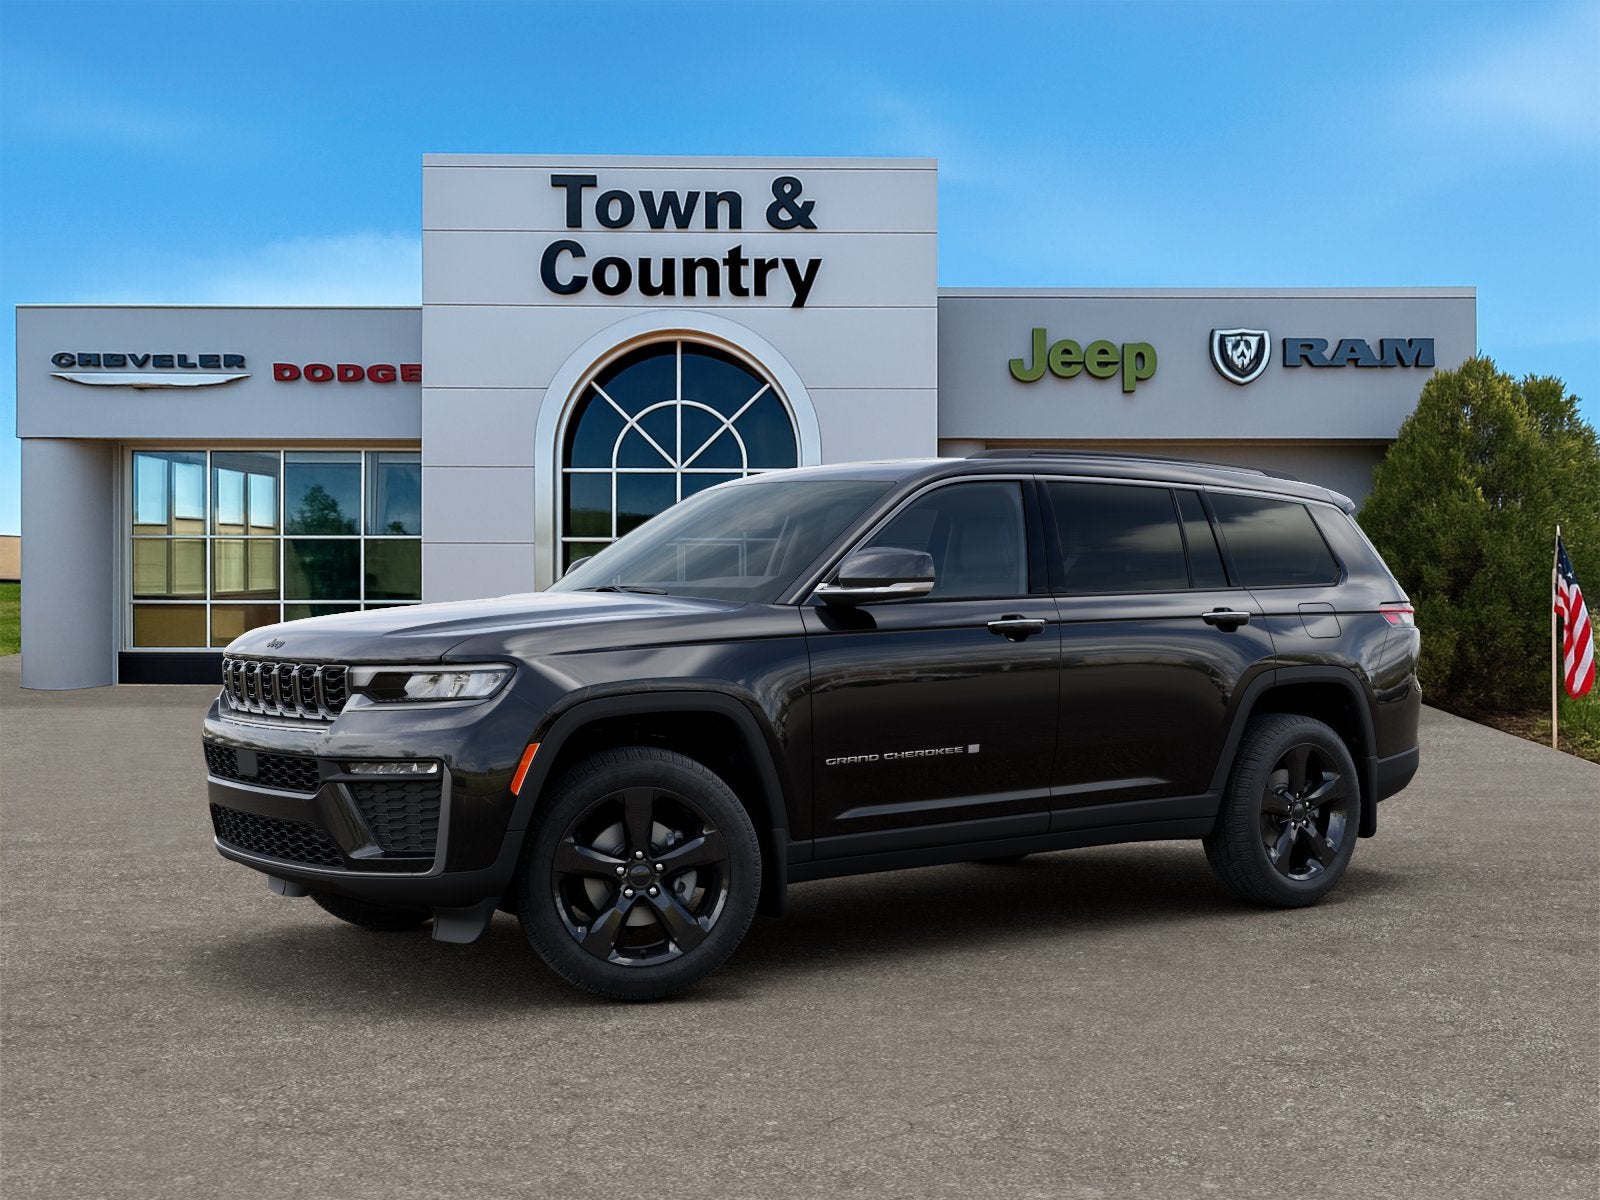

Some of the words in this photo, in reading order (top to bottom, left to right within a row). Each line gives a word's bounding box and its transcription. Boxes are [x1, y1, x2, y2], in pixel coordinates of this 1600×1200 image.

[551, 174, 742, 230] Town
[765, 176, 818, 230] &
[540, 239, 822, 308] Country
[273, 363, 421, 383] DODGE
[1009, 328, 1158, 393] Jeep
[1283, 337, 1435, 368] RAM
[825, 754, 879, 766] GRAND
[883, 746, 964, 760] CHEROKEE
